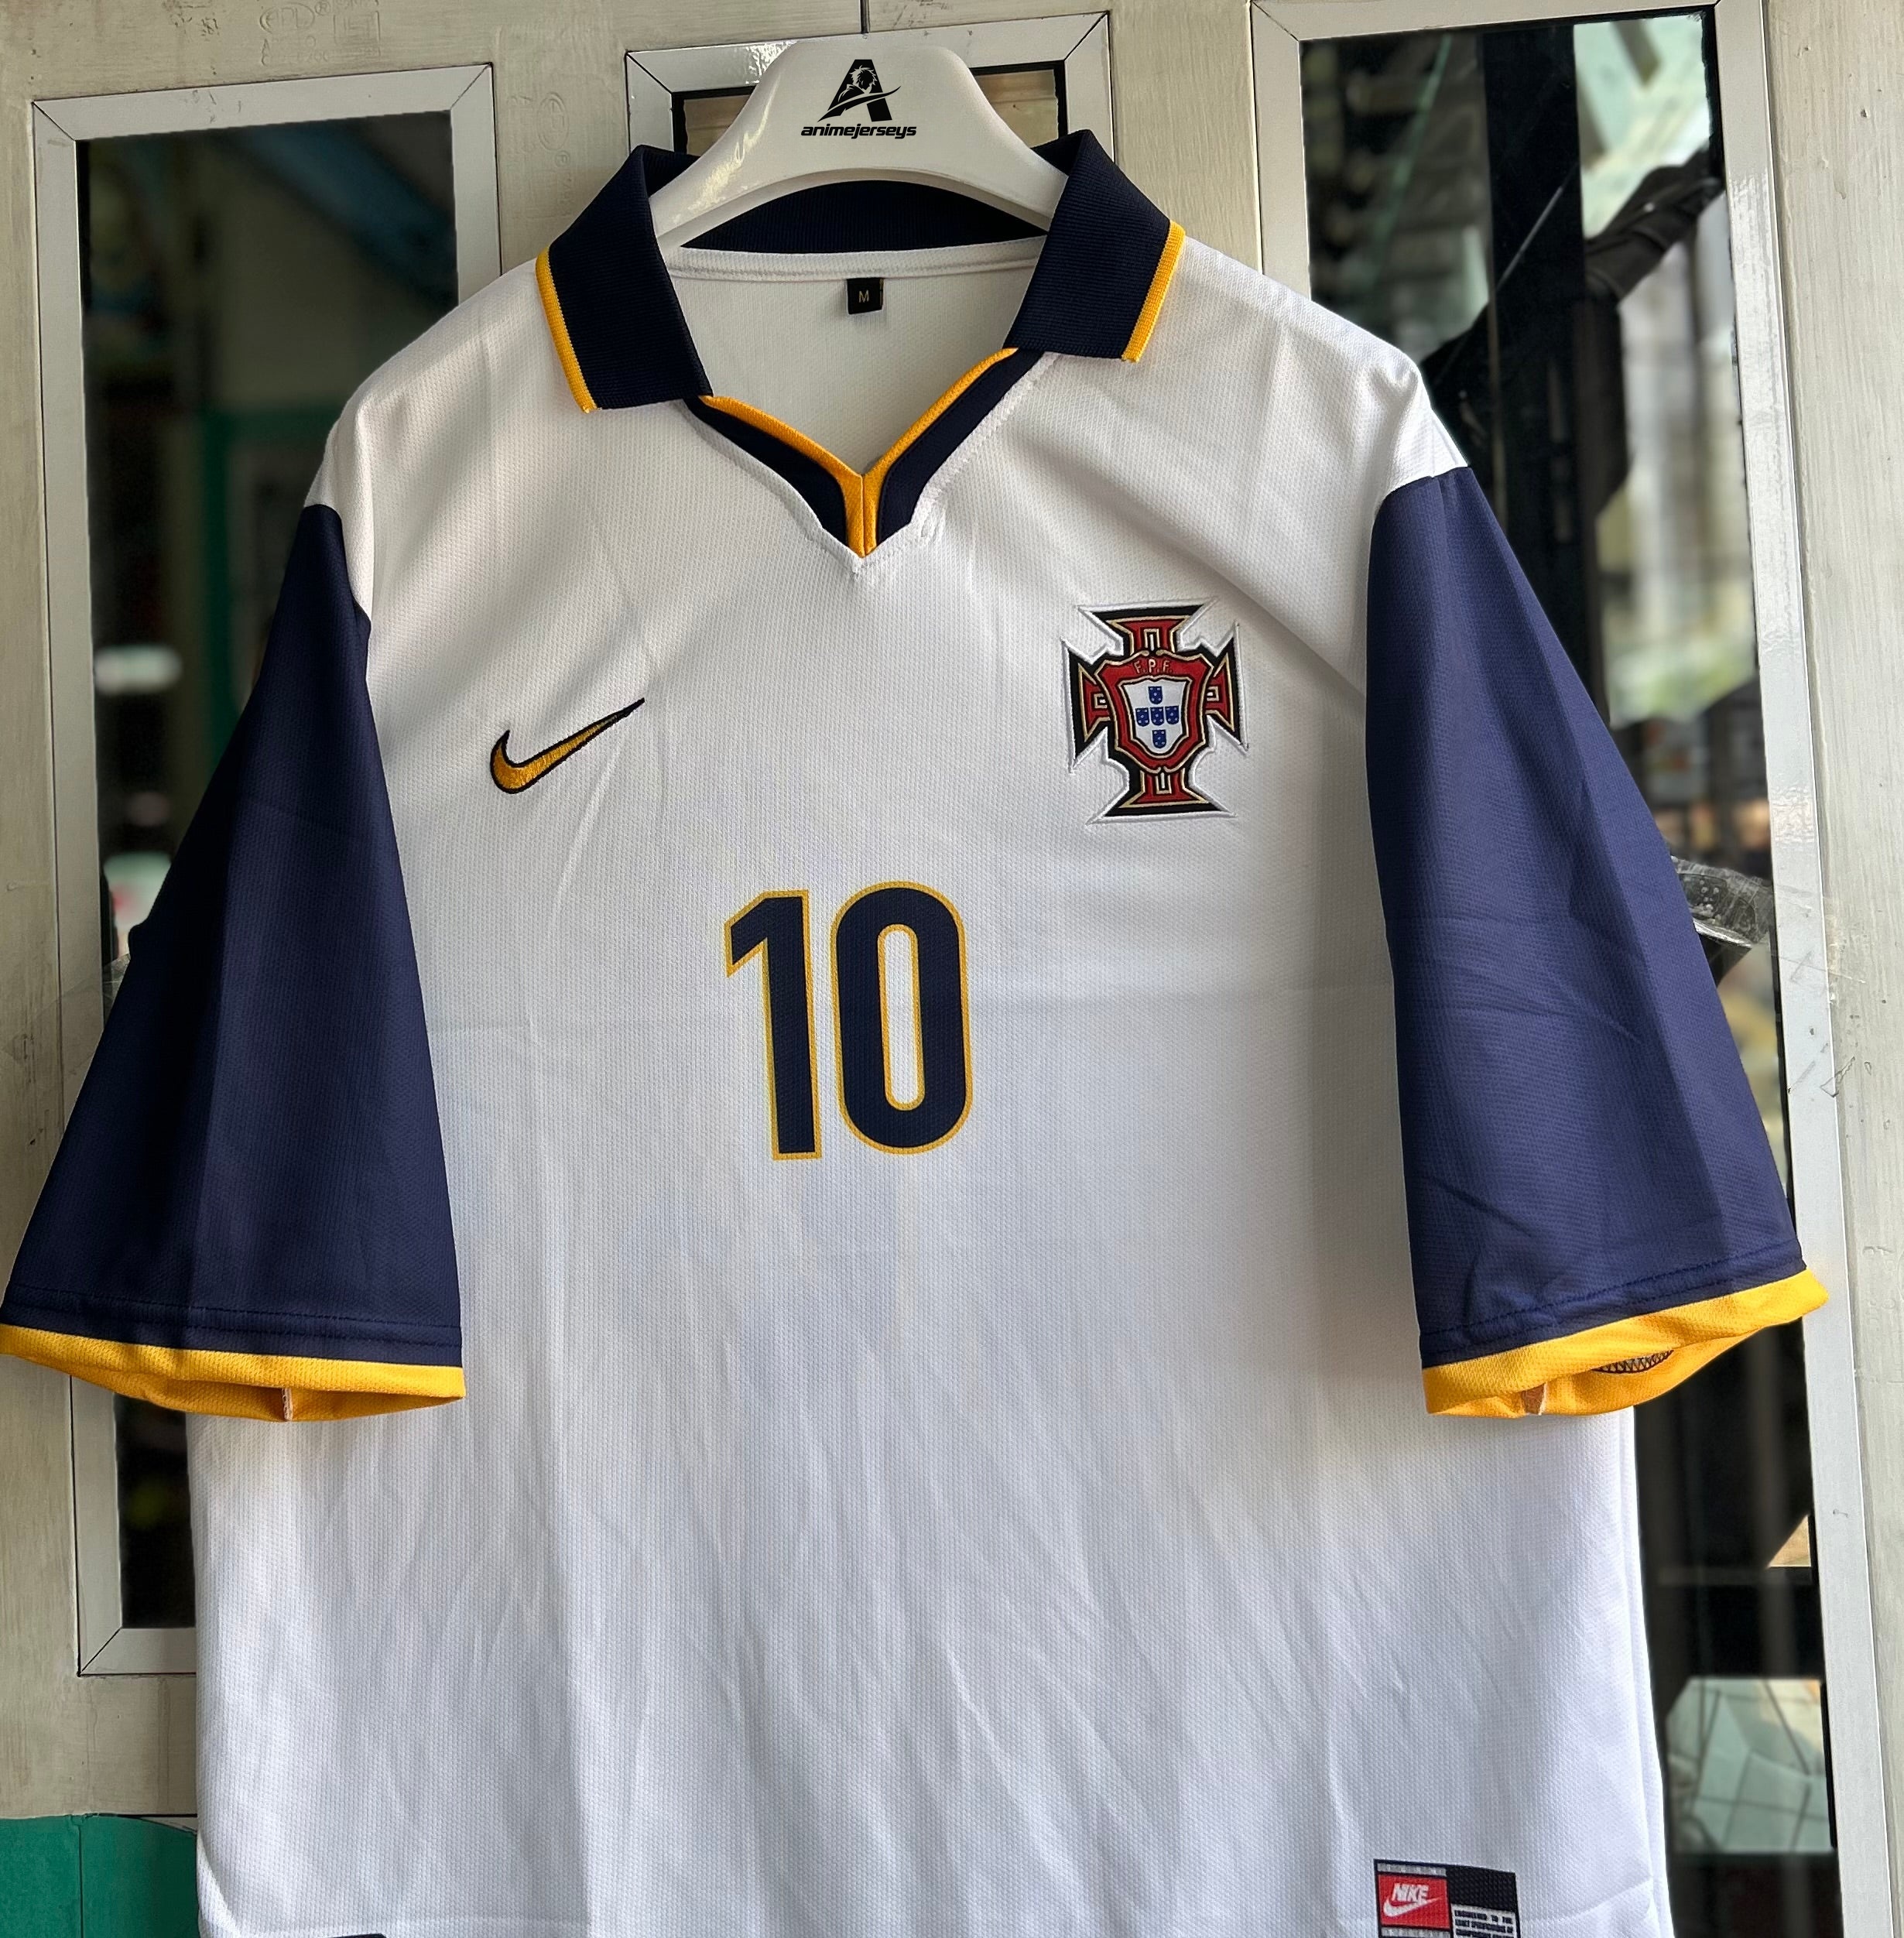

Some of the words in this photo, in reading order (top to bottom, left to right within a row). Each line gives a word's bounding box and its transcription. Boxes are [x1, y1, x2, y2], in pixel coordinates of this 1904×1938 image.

[801, 124, 917, 139] animejerseys
[858, 289, 869, 303] M
[724, 880, 973, 1161] 10
[1392, 1882, 1430, 1904] NIKE
